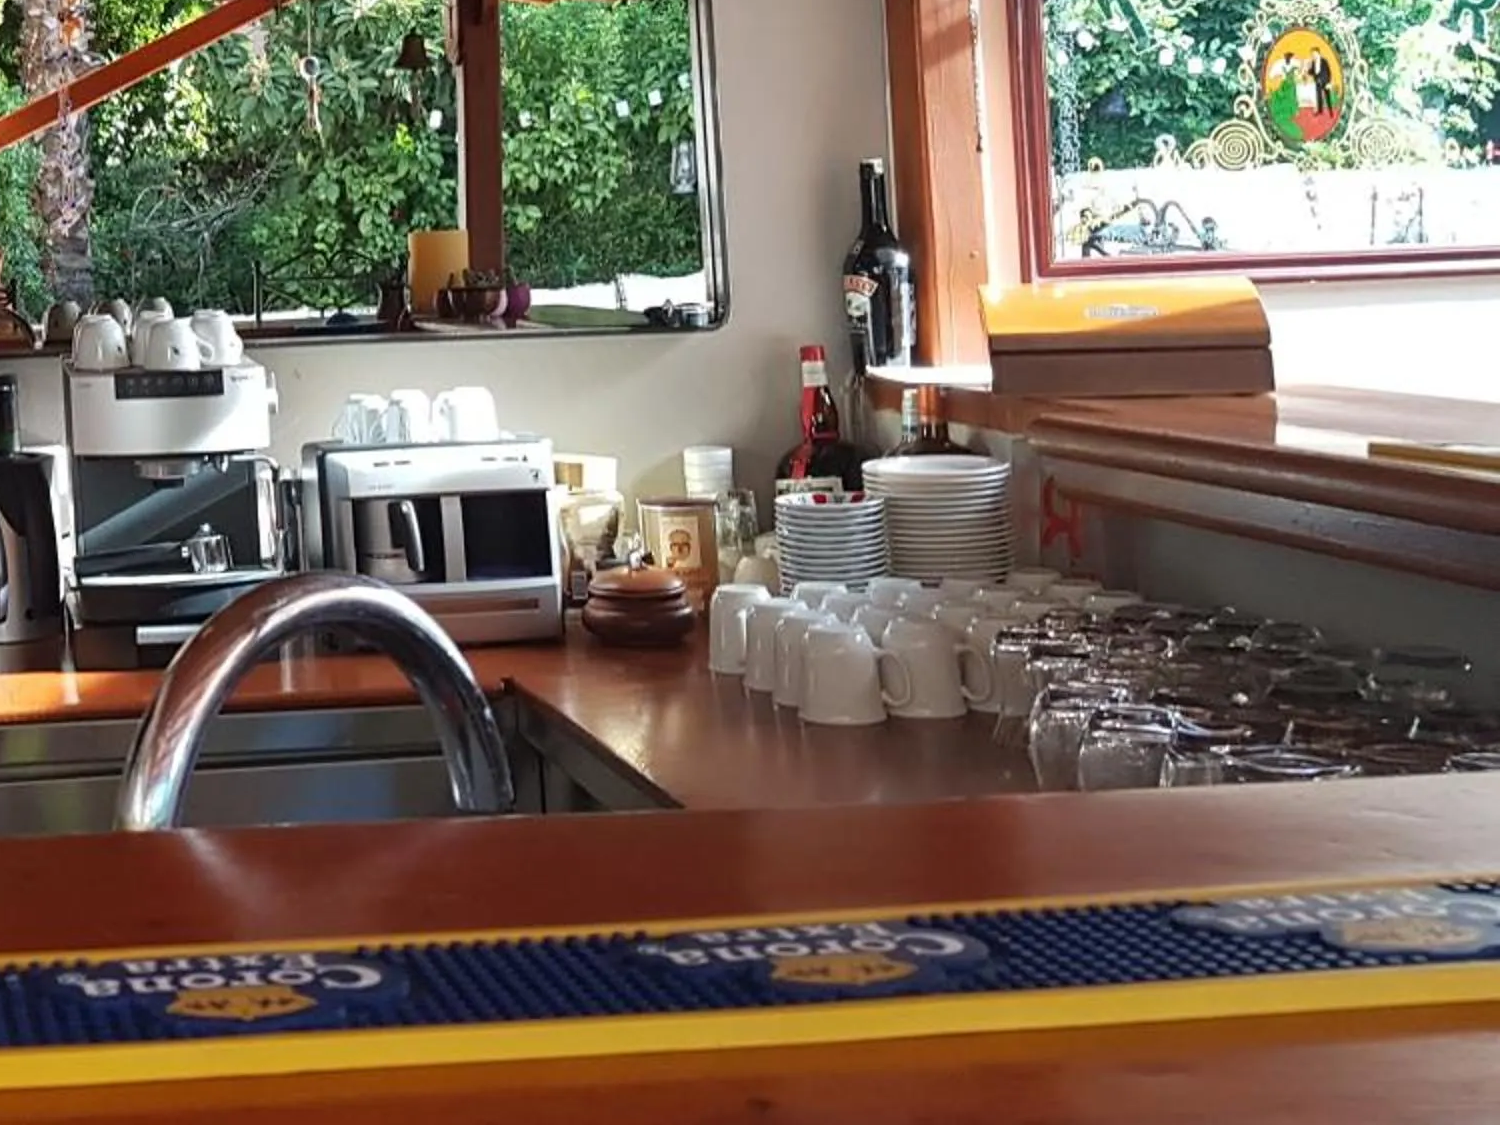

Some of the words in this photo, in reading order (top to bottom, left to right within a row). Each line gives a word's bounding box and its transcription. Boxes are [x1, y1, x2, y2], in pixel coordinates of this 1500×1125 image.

[122, 952, 319, 973] Extra
[665, 931, 965, 966] Corona
[82, 964, 382, 997] Corona
